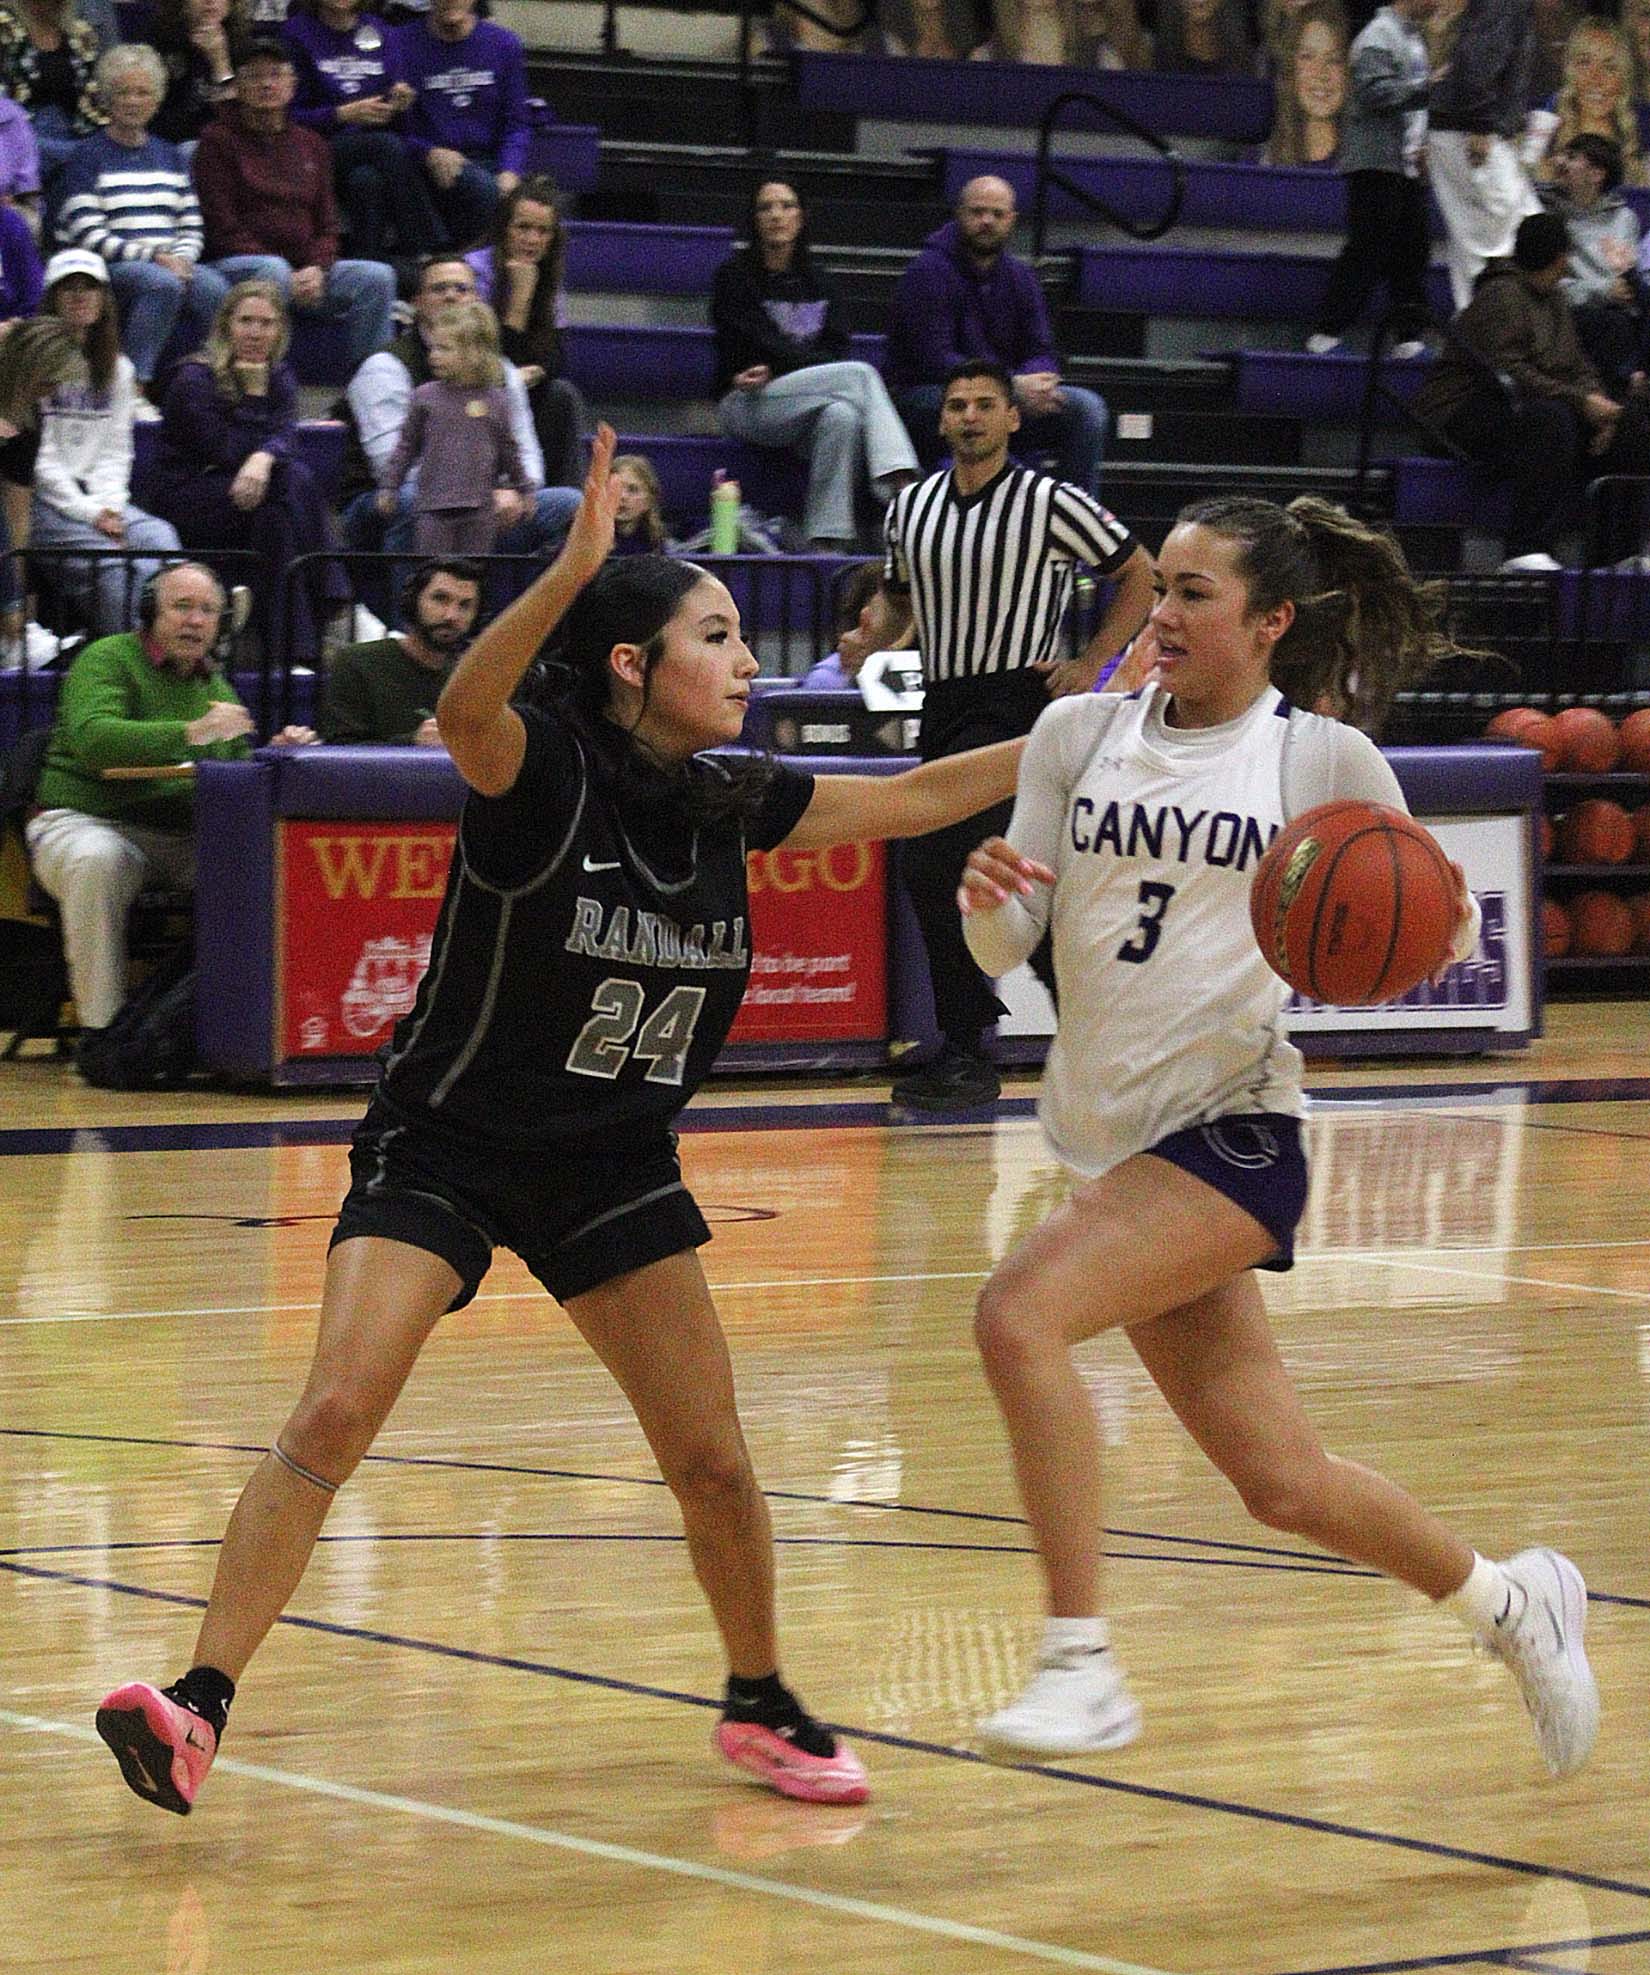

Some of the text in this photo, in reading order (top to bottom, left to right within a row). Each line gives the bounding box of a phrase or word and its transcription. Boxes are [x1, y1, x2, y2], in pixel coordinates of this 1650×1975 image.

[309, 836, 871, 899] WE GO
[1071, 797, 1279, 872] CANYON
[564, 896, 748, 969] RANDALL
[1116, 880, 1175, 964] 3
[565, 978, 707, 1086] 24
